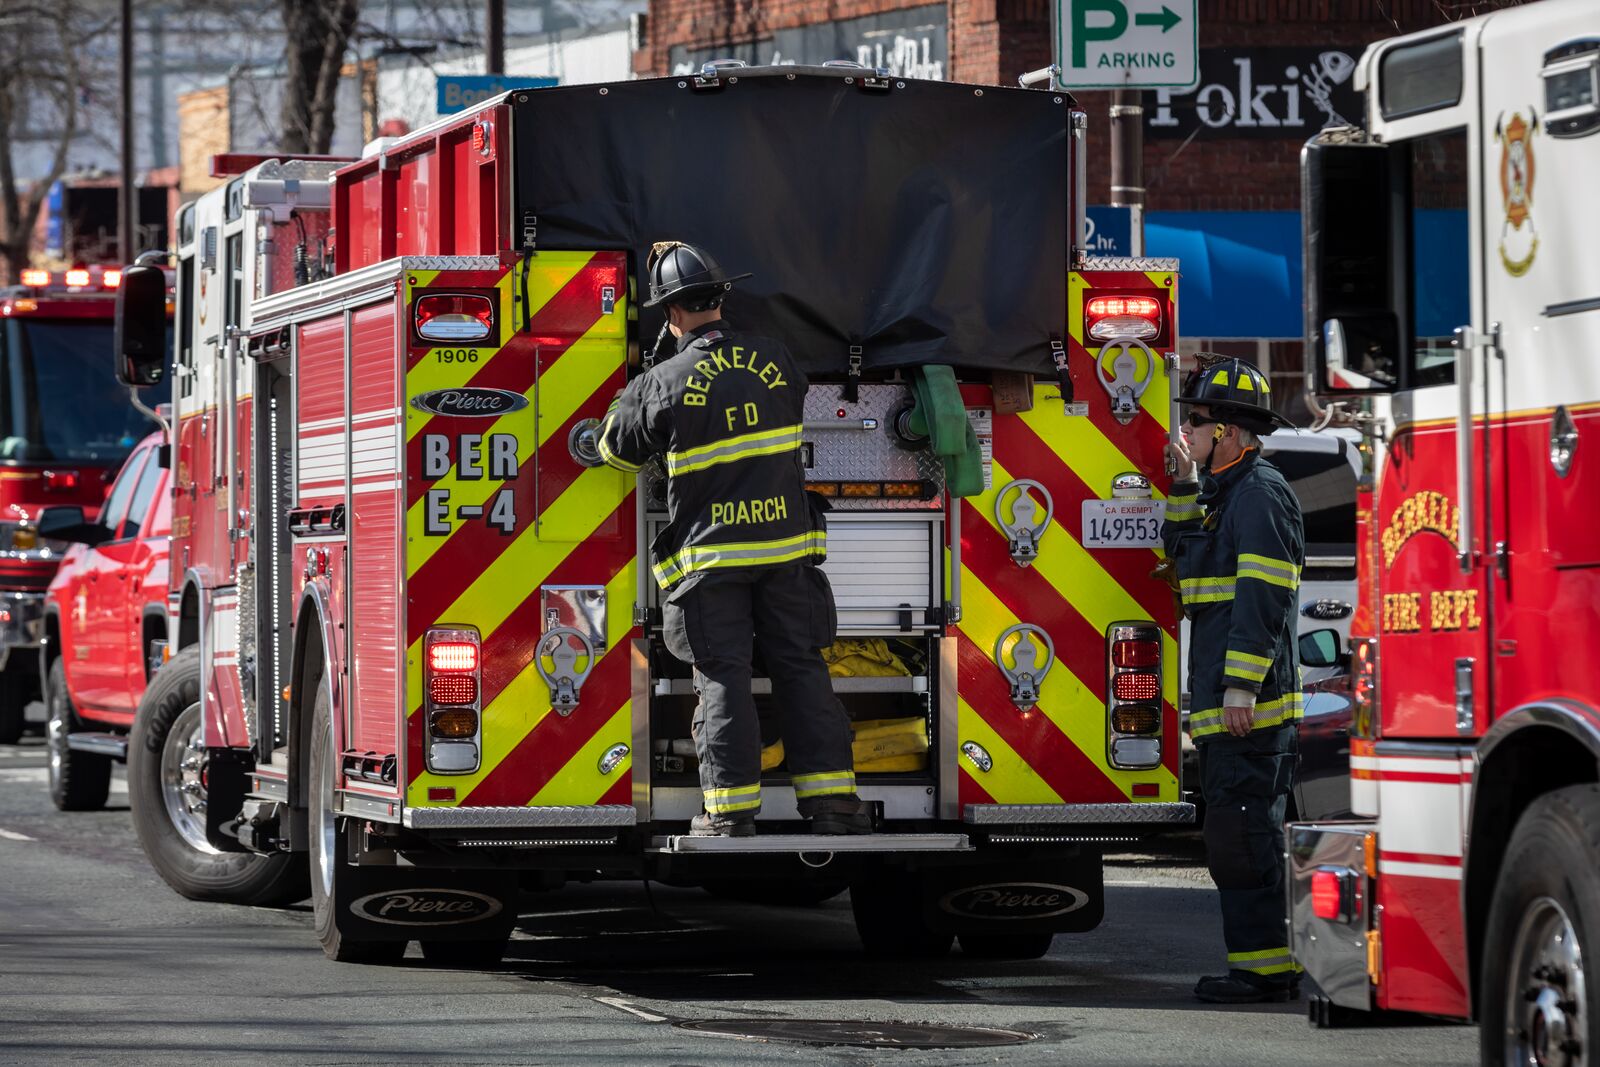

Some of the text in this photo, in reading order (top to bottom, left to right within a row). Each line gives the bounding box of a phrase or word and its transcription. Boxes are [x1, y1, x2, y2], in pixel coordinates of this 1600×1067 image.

[435, 349, 479, 364] 1906
[683, 346, 788, 407] BERKELEY
[437, 391, 502, 411] Pierce
[422, 433, 519, 480] BER
[424, 489, 517, 536] E-4
[711, 495, 788, 527] POARCH
[1120, 506, 1153, 514] EXEMPT
[1089, 518, 1165, 541] 149553
[1383, 593, 1422, 633] FIRE
[379, 895, 475, 916] Pierce
[967, 889, 1061, 911] Pierce
